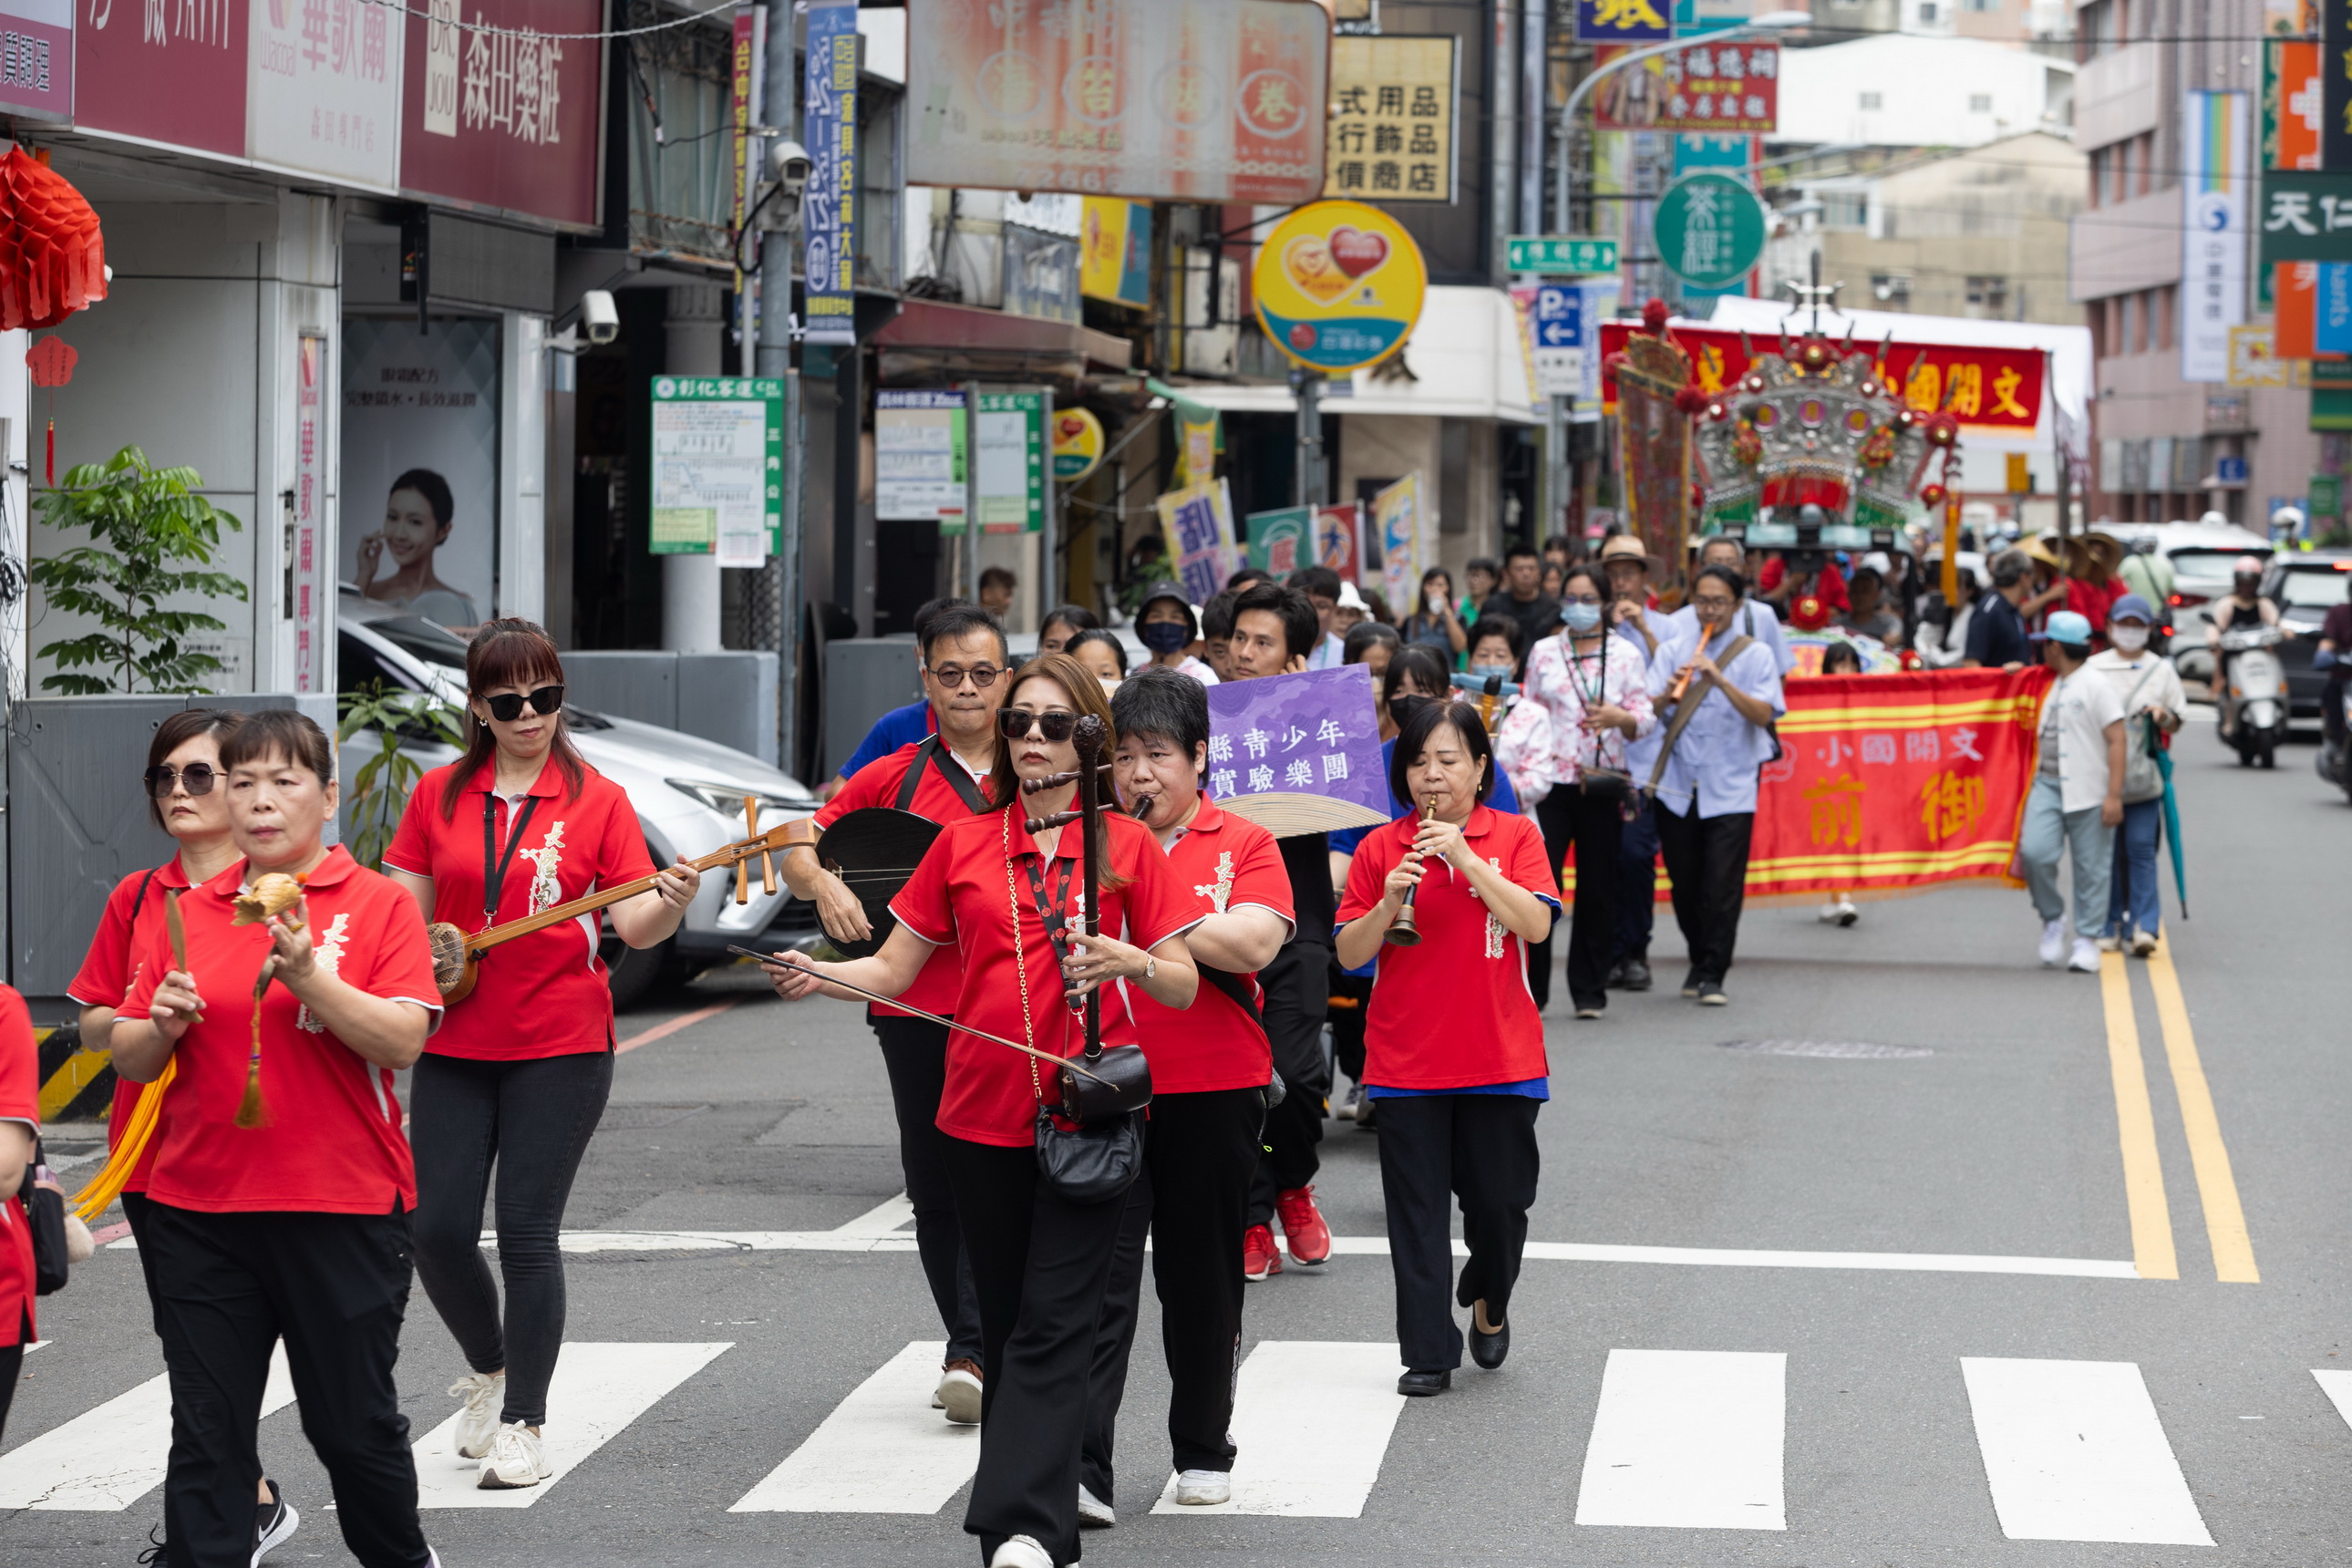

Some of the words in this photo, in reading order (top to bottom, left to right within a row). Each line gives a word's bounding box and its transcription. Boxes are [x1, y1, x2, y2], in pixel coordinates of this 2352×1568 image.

[0, 30, 50, 92] 質調理
[461, 11, 563, 146] 森田藥粧
[428, 71, 455, 118] JOU
[2264, 191, 2352, 236] 天仁
[678, 379, 755, 397] 彰化客運
[1208, 718, 1346, 765] 縣青少年
[1210, 752, 1349, 801] 實驗樂團
